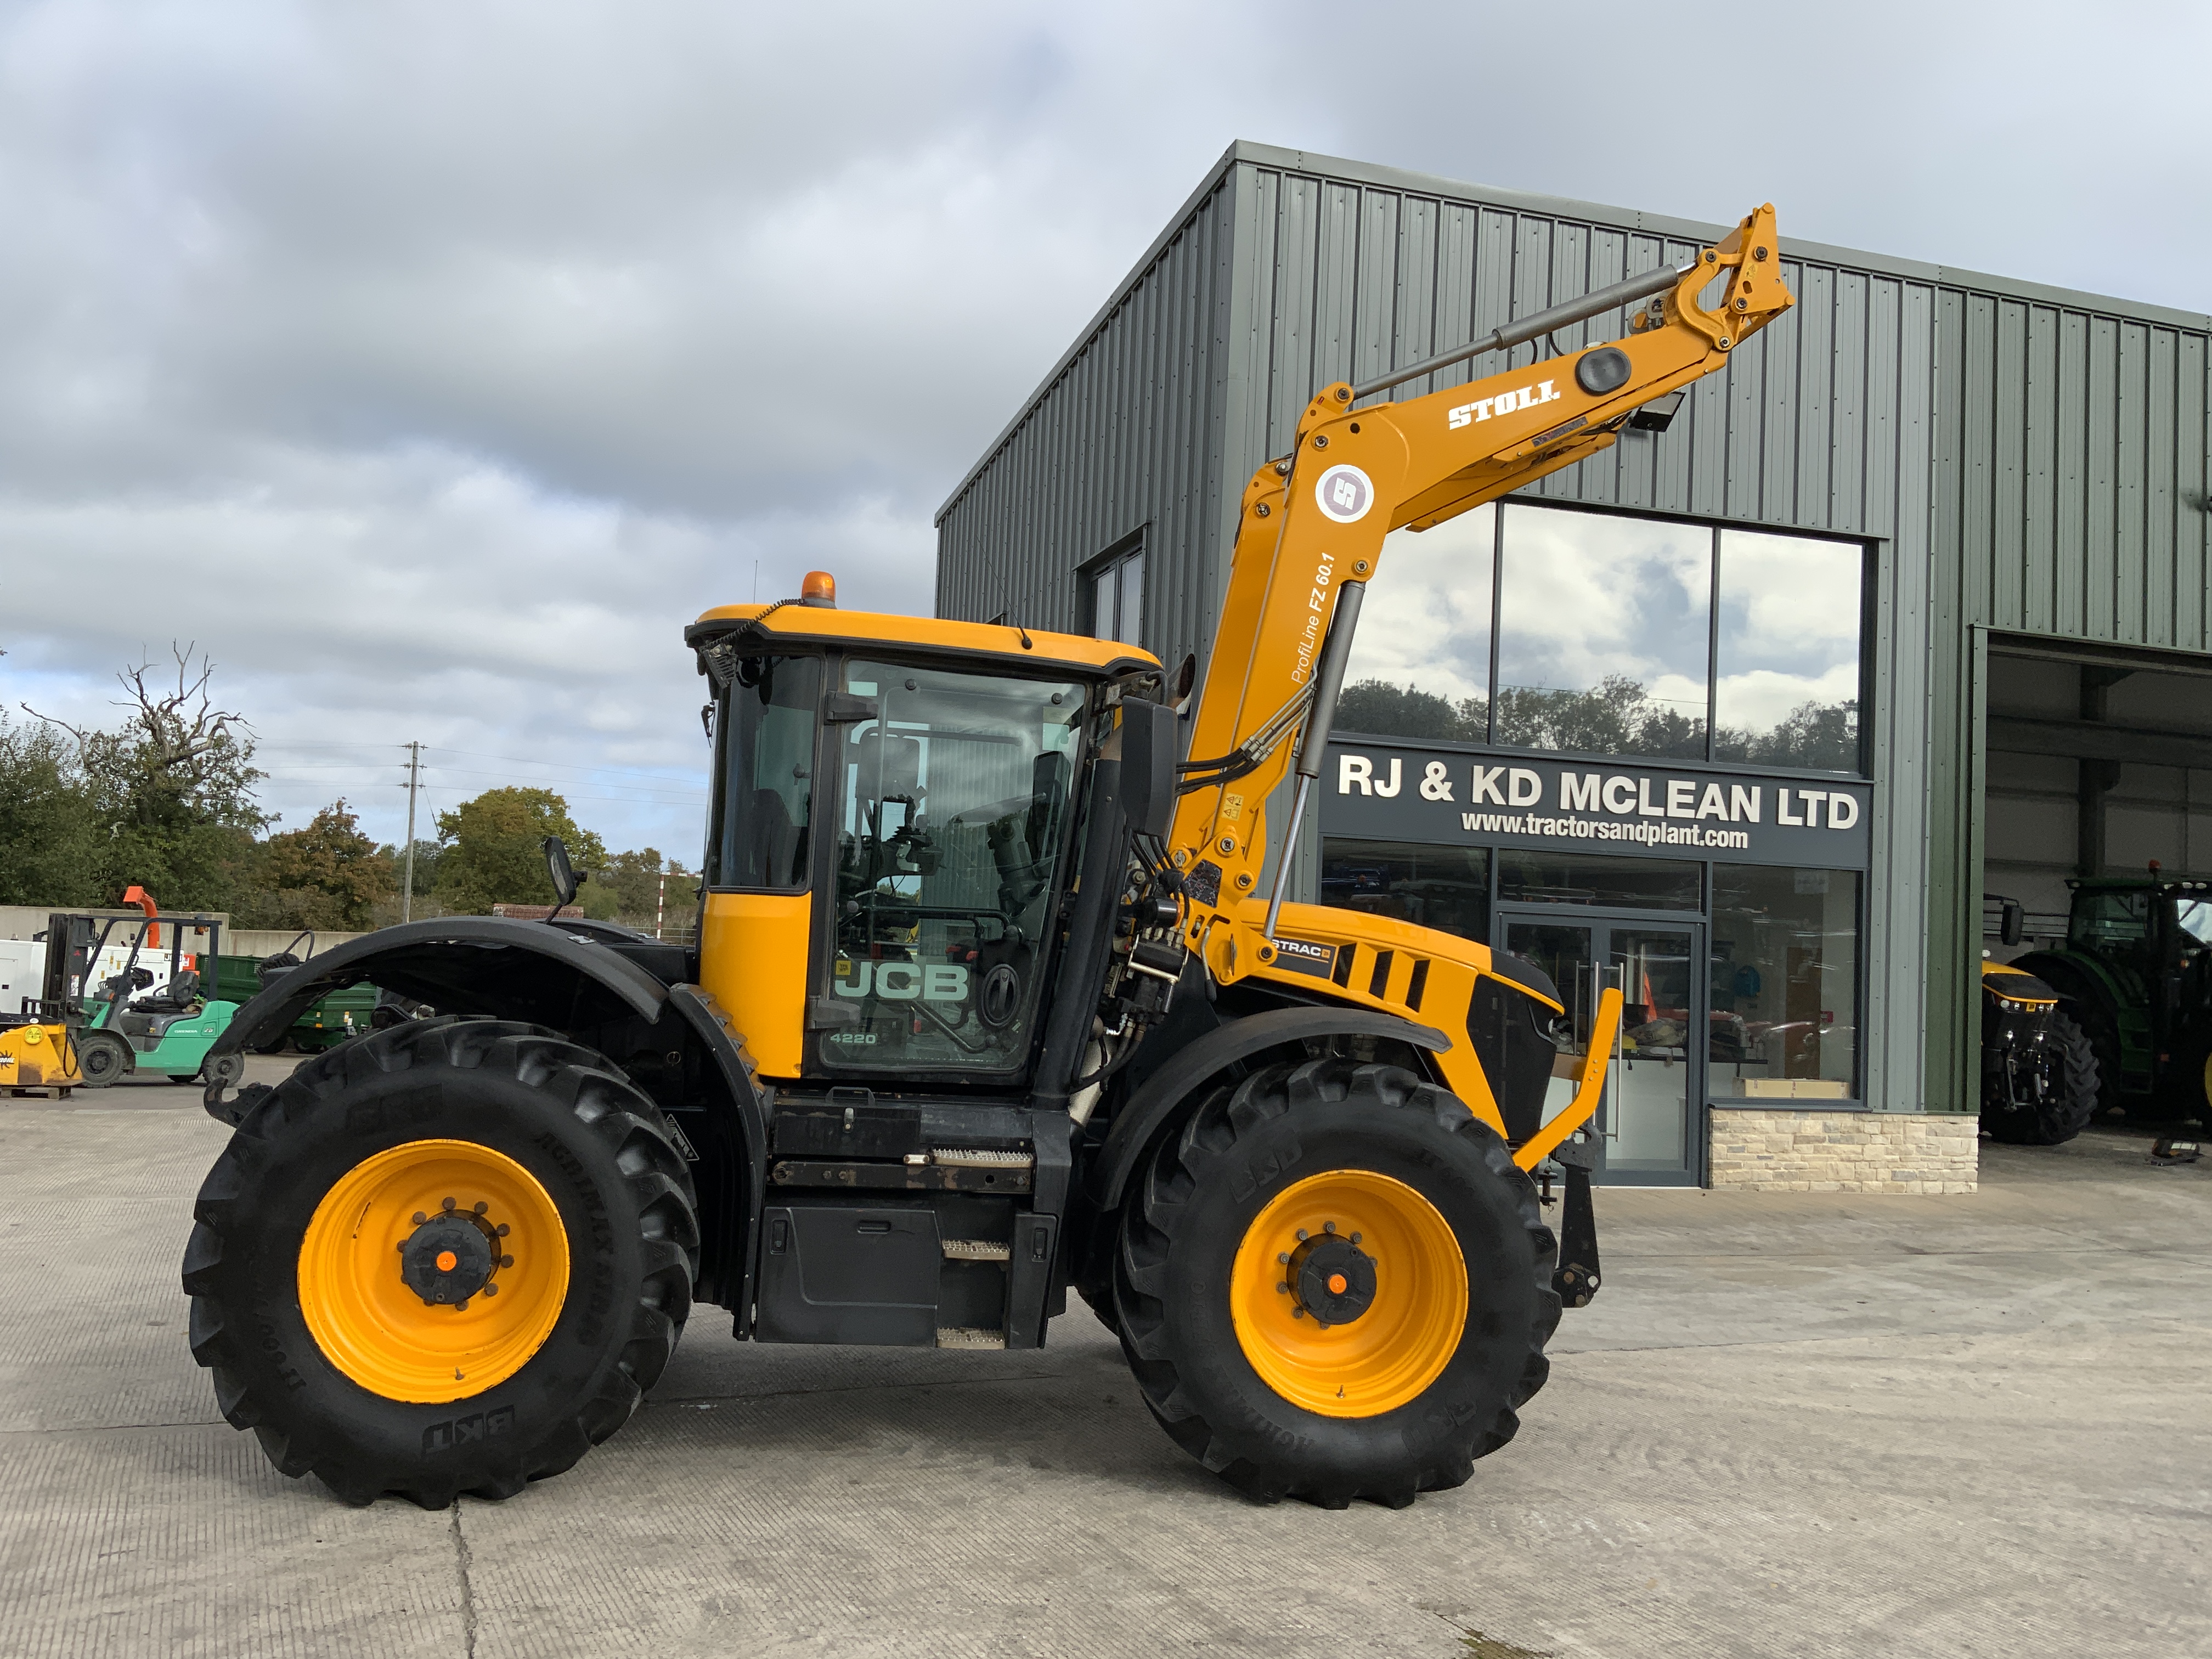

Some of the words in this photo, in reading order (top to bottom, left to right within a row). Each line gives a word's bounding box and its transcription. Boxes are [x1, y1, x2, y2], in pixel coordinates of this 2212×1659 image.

[1449, 379, 1560, 430] STOLL
[1316, 552, 1335, 586] 60.1
[1309, 587, 1327, 613] FZ
[1291, 615, 1320, 685] ProfiLine
[1338, 754, 1402, 798] RJ
[1419, 760, 1455, 803] &
[1471, 765, 1542, 807] KD
[1560, 773, 1760, 823] MCLEAN
[1776, 788, 1859, 830] LTD
[1461, 811, 1748, 849] www.tractorsandplant.com
[1272, 939, 1322, 956] STRAC
[835, 961, 968, 1001] JCB
[830, 1033, 876, 1044] 4220
